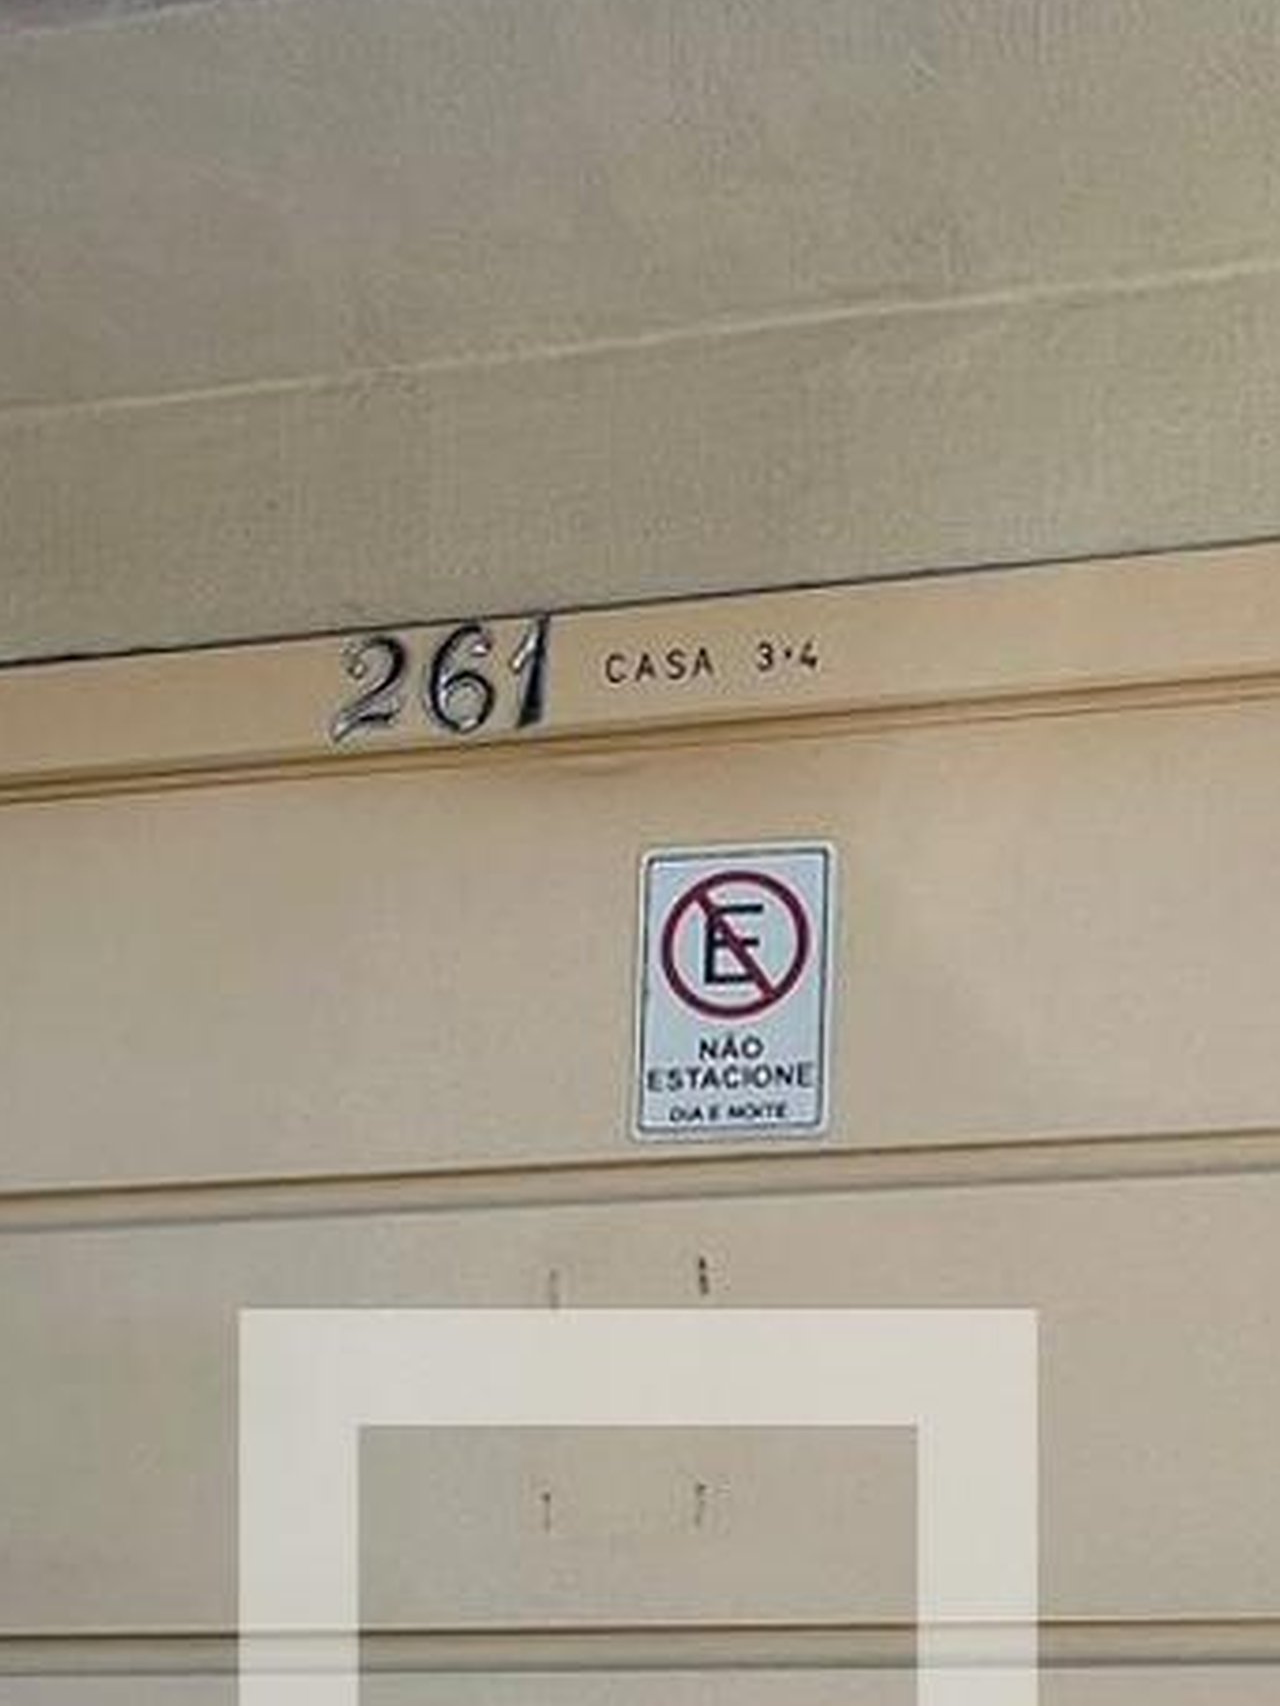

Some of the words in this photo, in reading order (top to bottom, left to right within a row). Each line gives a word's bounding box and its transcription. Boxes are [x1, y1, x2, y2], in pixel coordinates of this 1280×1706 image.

[331, 614, 550, 744] 261
[605, 647, 714, 684] CASA
[703, 903, 764, 985] E
[647, 1063, 813, 1093] ESTACIONE
[670, 1104, 703, 1123] DIA
